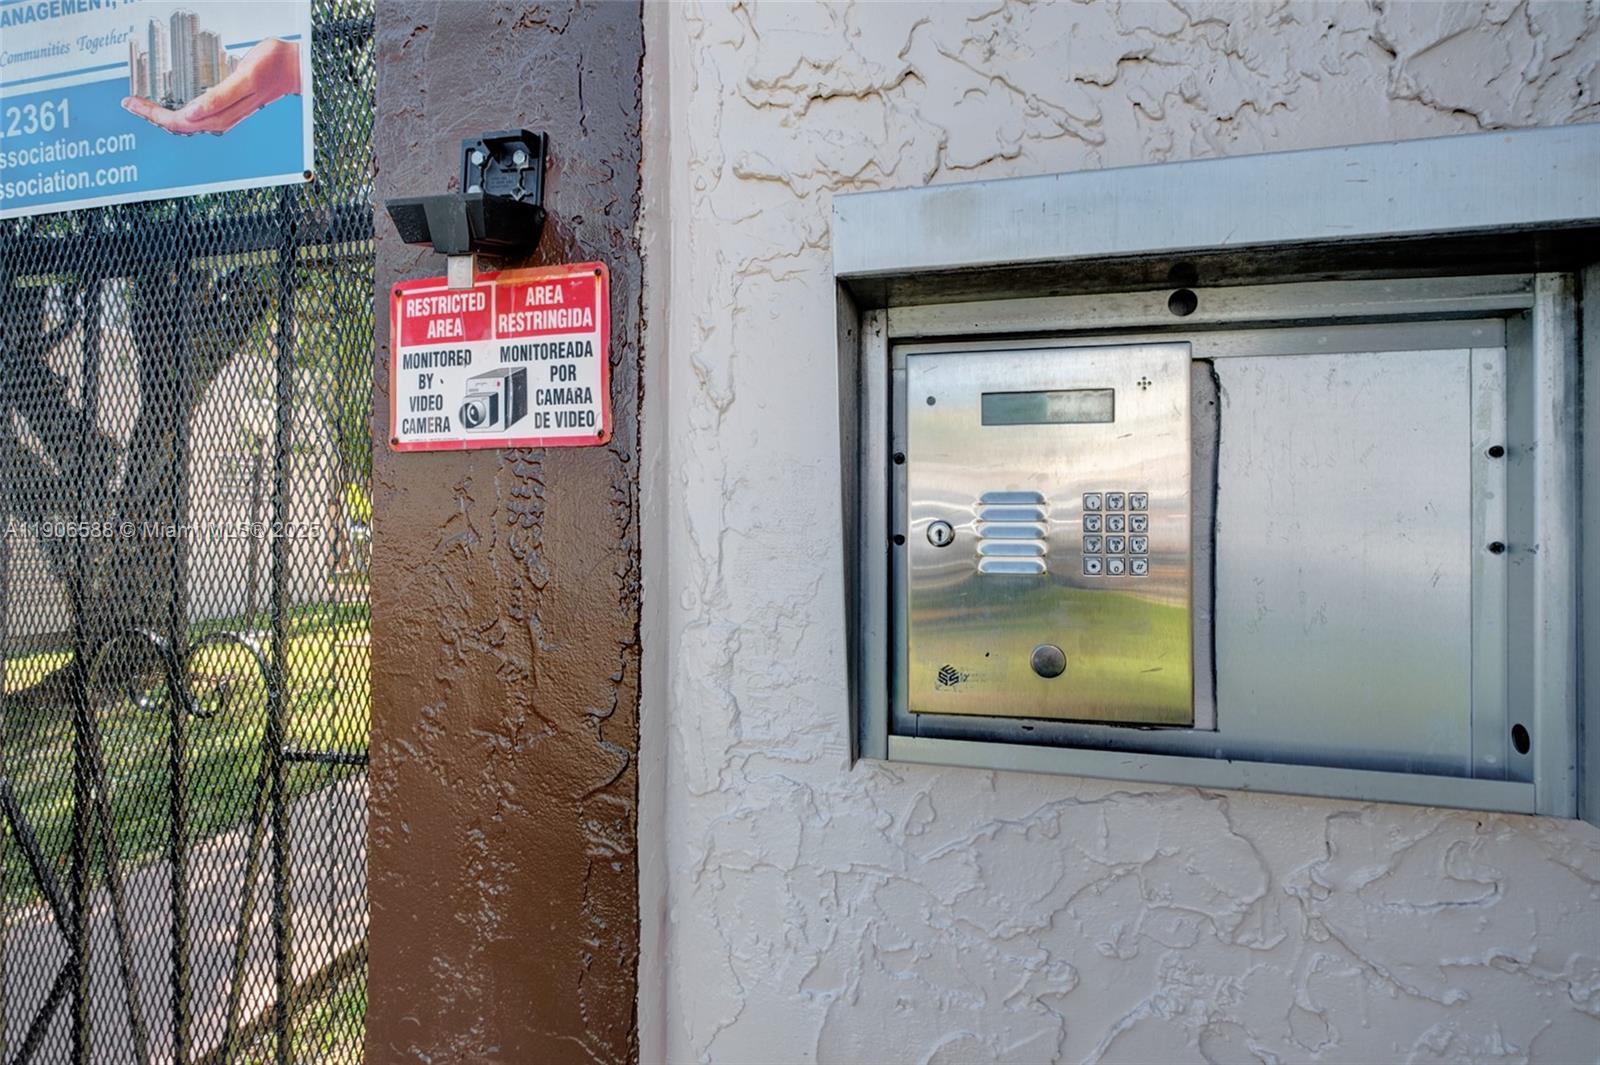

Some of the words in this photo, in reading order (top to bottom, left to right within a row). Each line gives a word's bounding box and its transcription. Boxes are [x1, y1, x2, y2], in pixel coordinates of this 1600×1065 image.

[406, 292, 486, 318] RESTRICTED
[525, 284, 564, 307] AREA
[426, 317, 464, 339] AREA
[498, 306, 593, 333] RESTRINGIDA
[403, 349, 472, 369] MONITORED
[500, 340, 594, 363] MONITOREADA
[418, 373, 434, 390] BY
[550, 364, 577, 382] POR
[409, 394, 444, 412] VIDEO
[536, 387, 593, 406] CAMARA
[402, 416, 451, 434] CAMERA
[534, 412, 550, 429] DE
[555, 410, 595, 428] VIDEO
